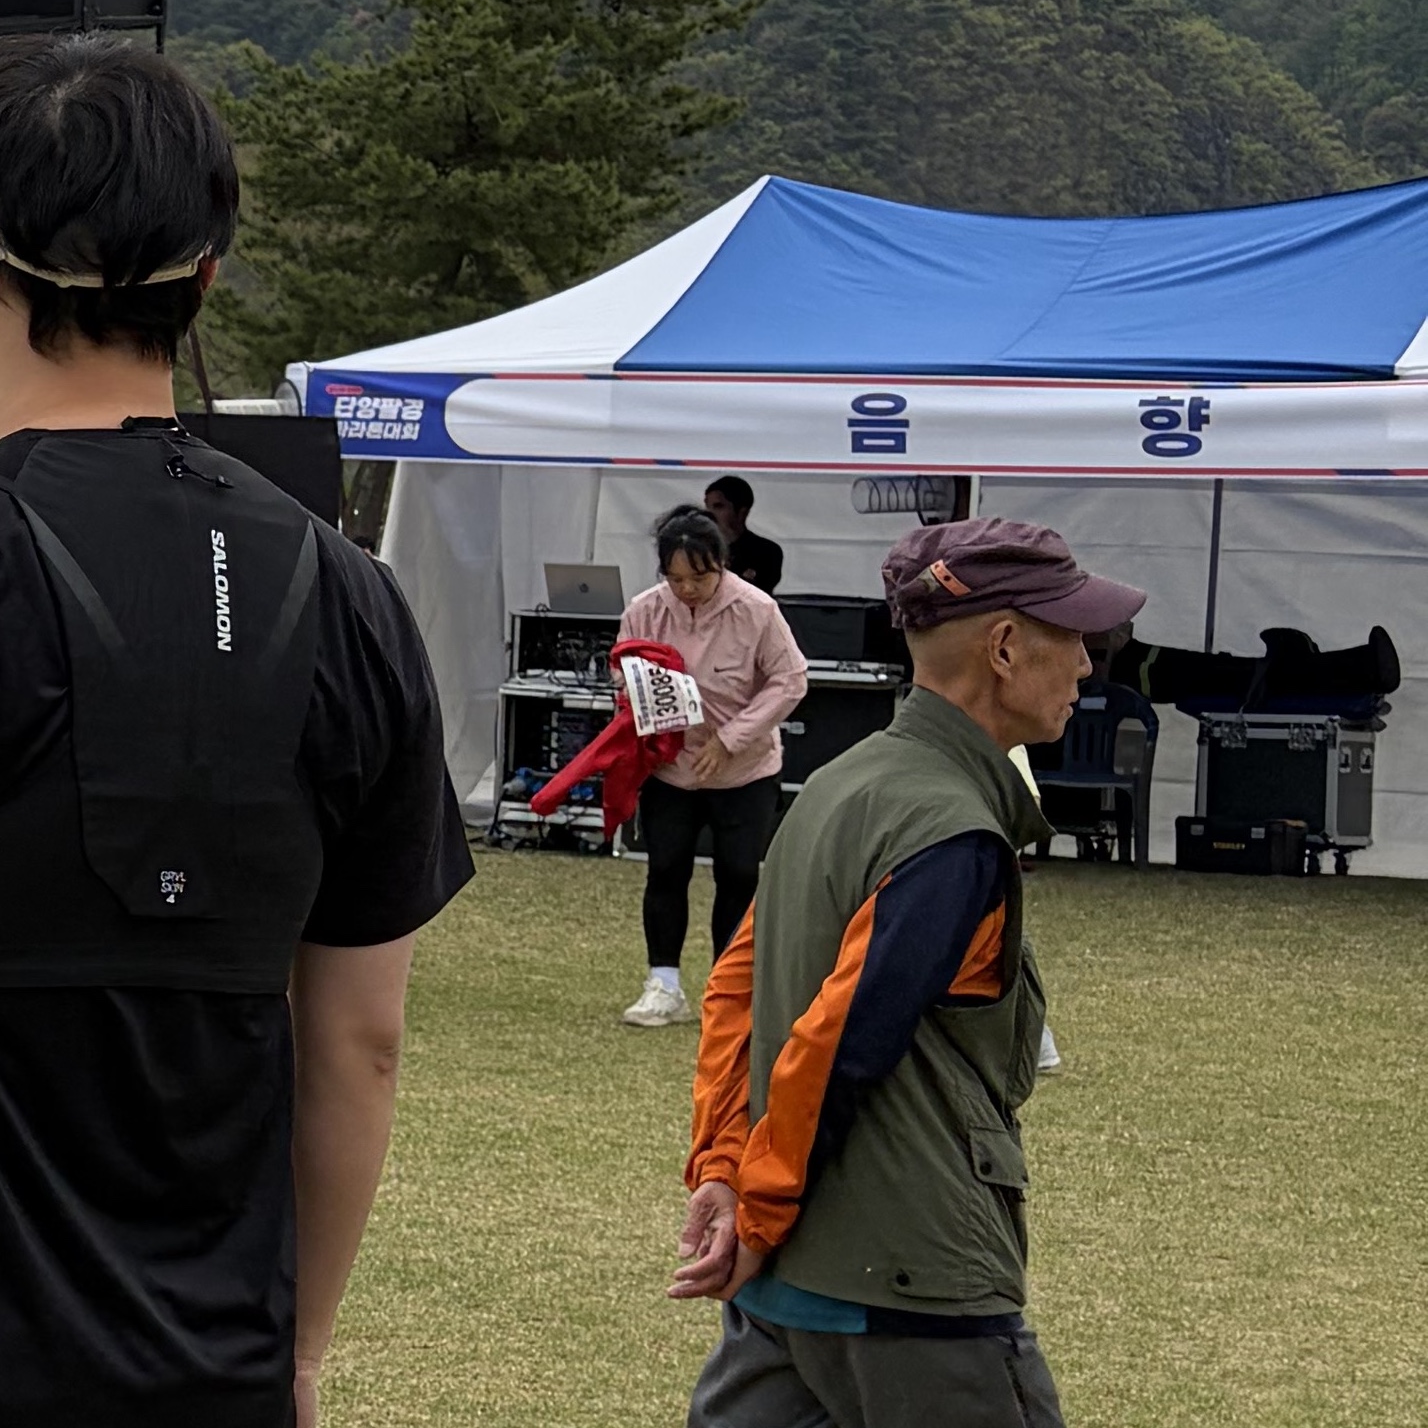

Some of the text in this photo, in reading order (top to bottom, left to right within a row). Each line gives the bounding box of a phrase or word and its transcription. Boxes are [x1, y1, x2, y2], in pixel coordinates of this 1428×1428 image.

[334, 396, 425, 421] 단양팔경
[848, 392, 1212, 458] 음 향
[211, 529, 233, 652] SALOMON
